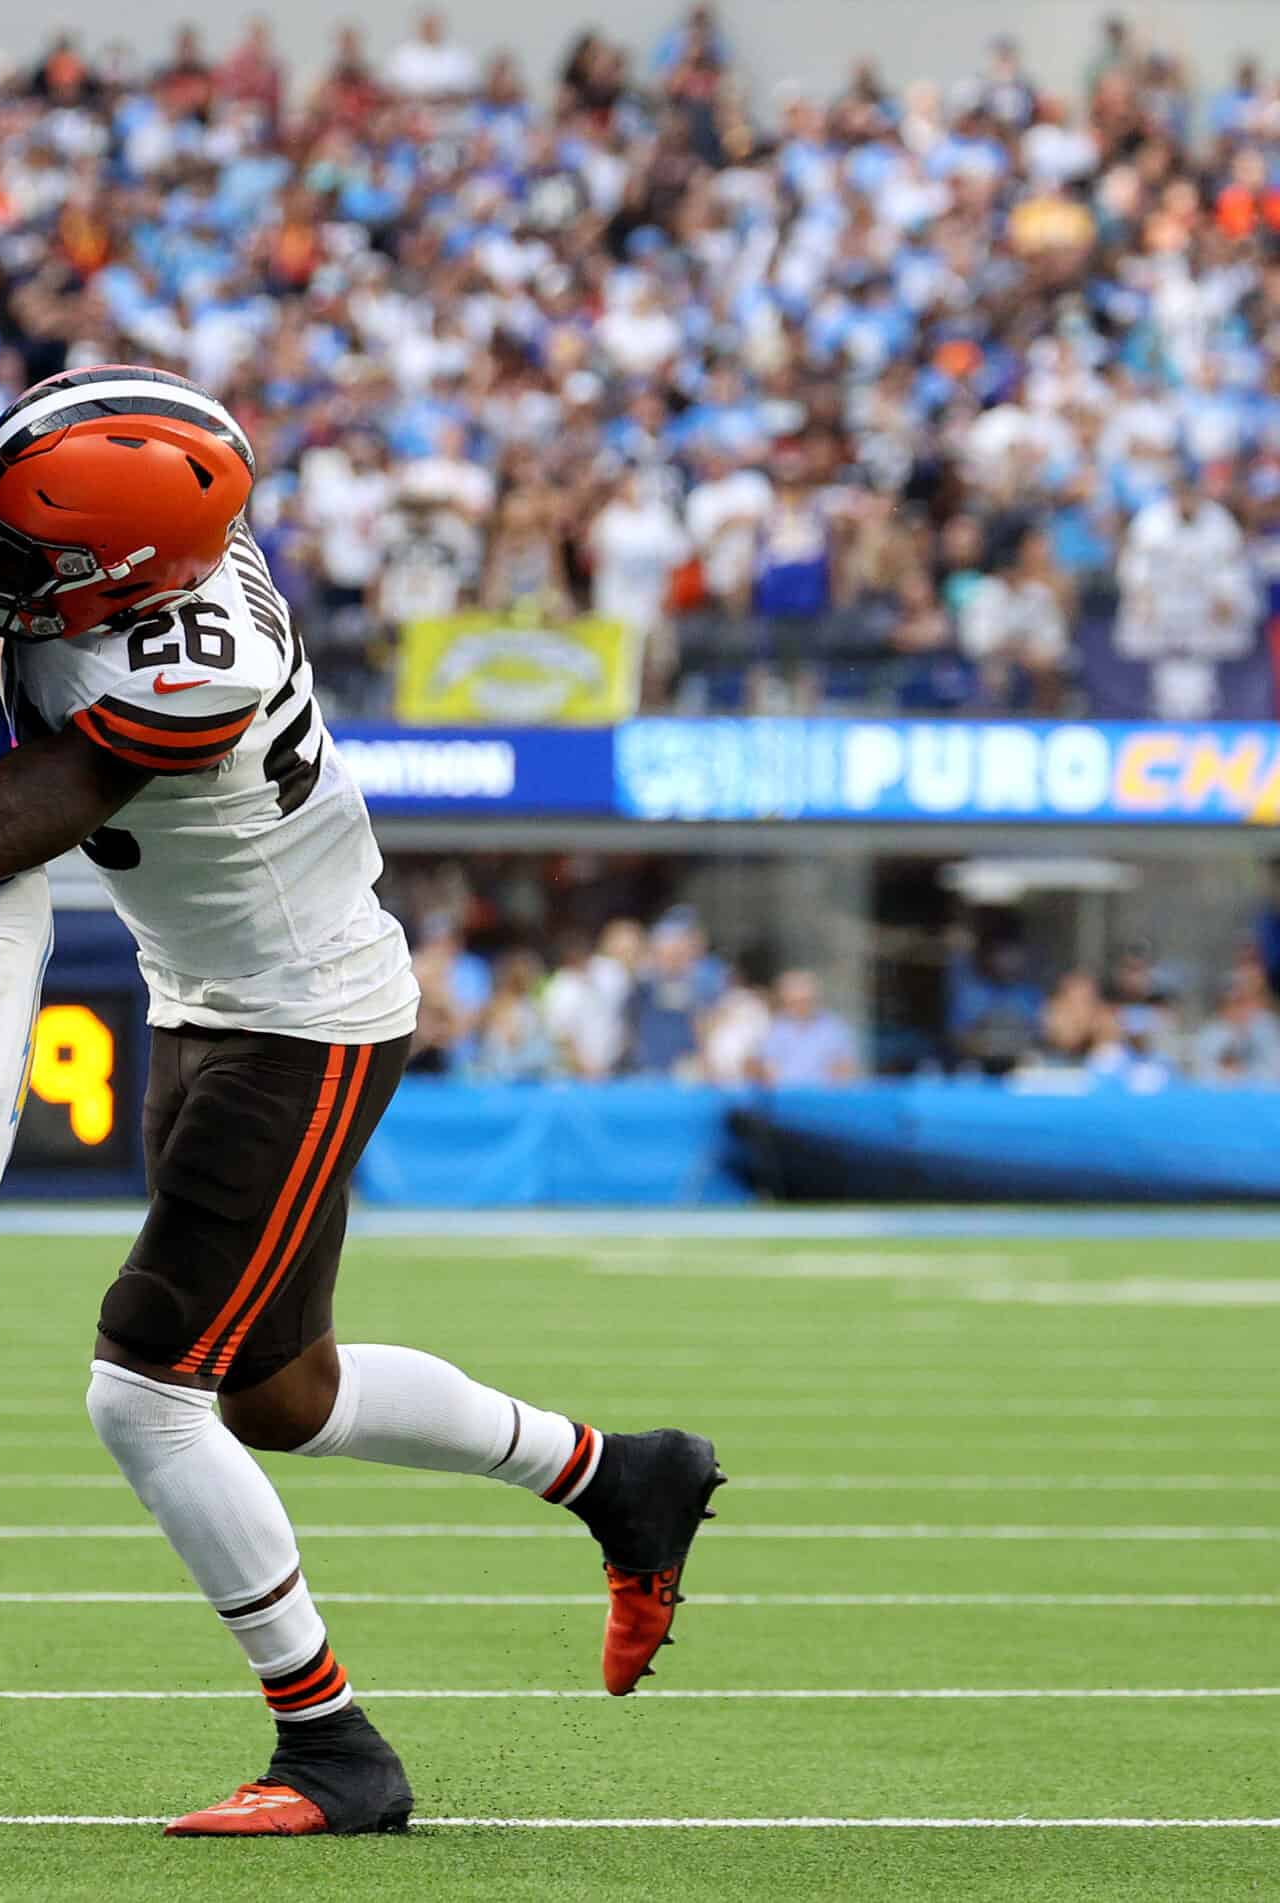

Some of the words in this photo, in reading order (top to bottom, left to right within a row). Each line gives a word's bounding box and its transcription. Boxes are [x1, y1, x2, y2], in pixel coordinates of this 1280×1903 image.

[127, 601, 235, 671] 26
[842, 723, 1109, 813] PURO
[31, 1004, 114, 1146] 9
